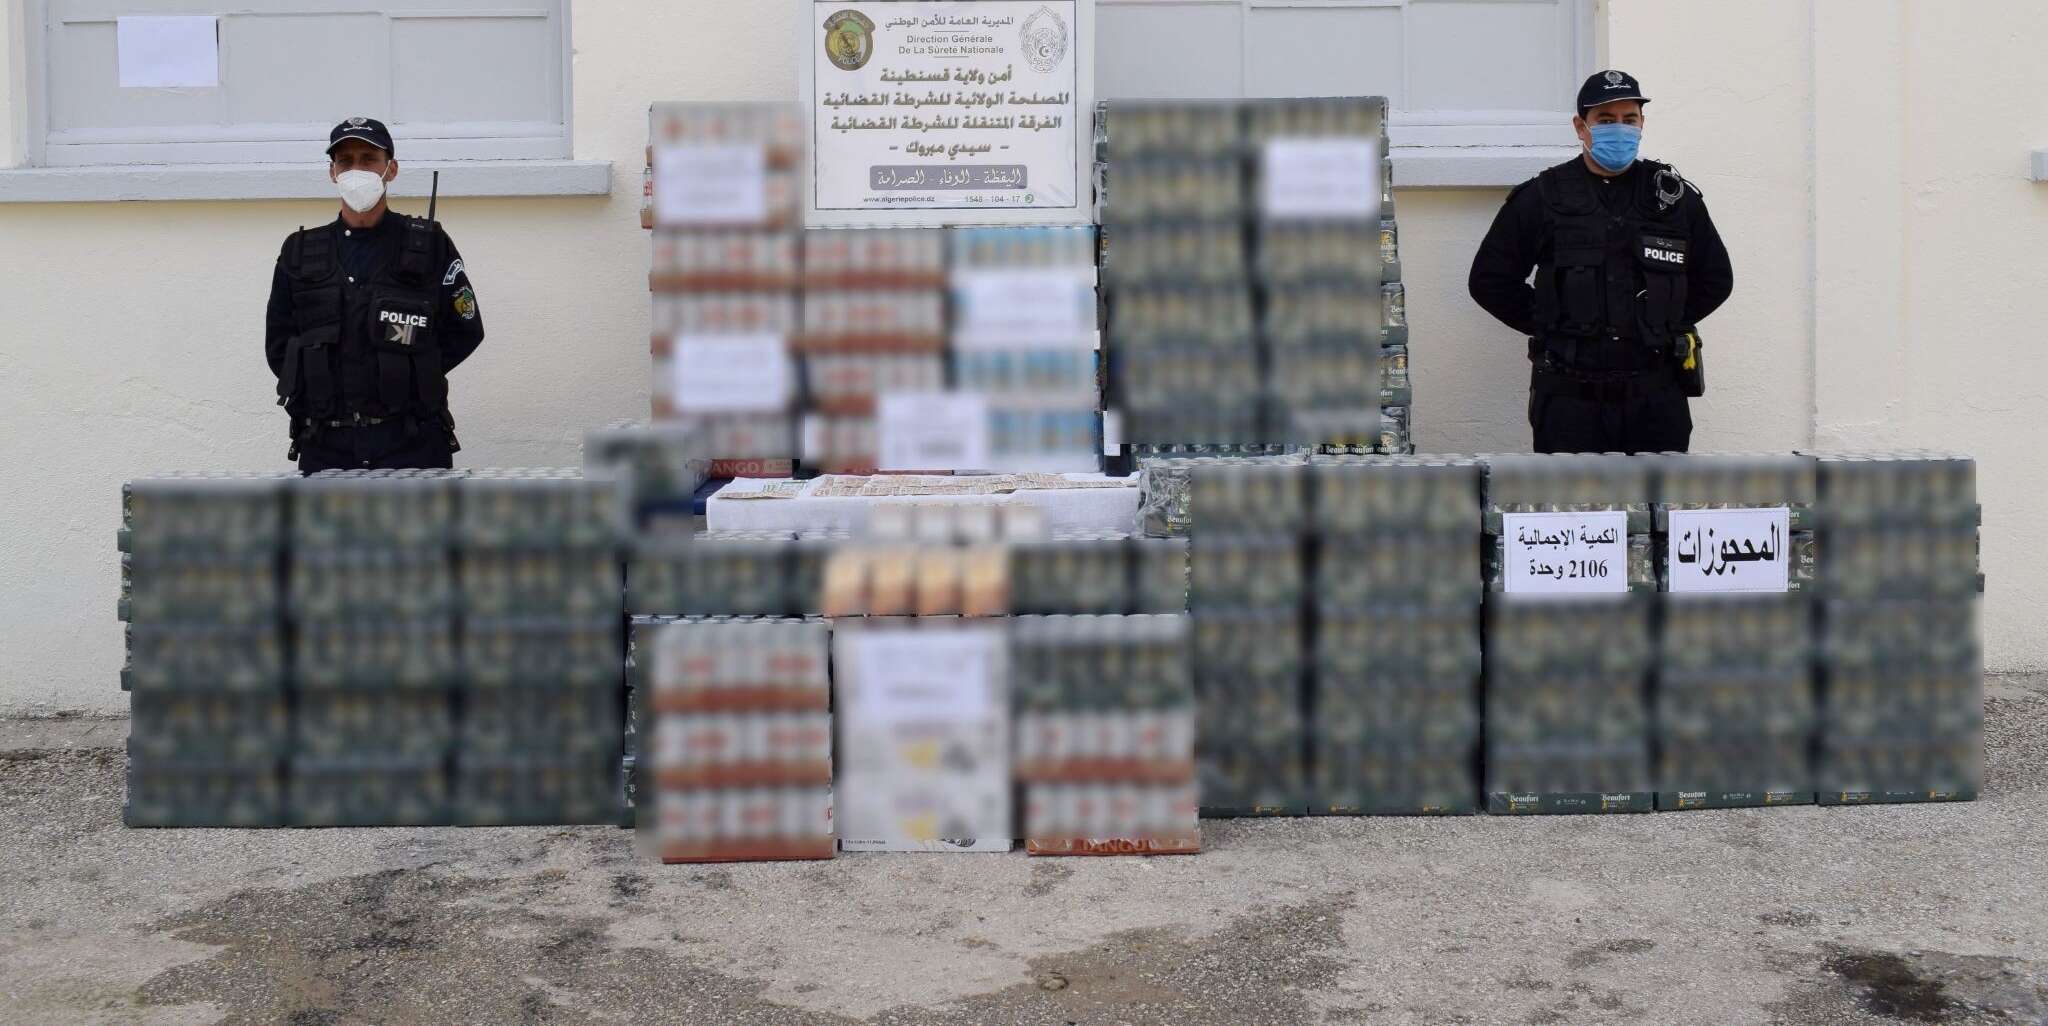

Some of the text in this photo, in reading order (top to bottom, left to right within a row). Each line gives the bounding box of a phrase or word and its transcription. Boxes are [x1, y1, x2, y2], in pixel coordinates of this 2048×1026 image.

[885, 16, 919, 32] الوطني
[921, 13, 946, 28] للأمن
[949, 15, 979, 25] العامة
[982, 15, 1014, 27] المديرية
[906, 34, 993, 43] Direction Générale
[898, 46, 911, 54] De
[913, 46, 926, 54] La
[960, 45, 1004, 54] Nationale
[880, 63, 1012, 86] أمن ولاية قسنطينة
[823, 90, 1070, 110] المصلحة الولائية للشرطة القضائية
[831, 113, 1062, 134] الفرقة المتنقلة للشرطة القضائية
[905, 141, 945, 157] مبروك
[947, 142, 992, 160] سيدي
[877, 167, 926, 188] الصرامة
[939, 168, 970, 187] الوفاء
[983, 167, 1022, 188] اليقظة
[1644, 247, 1685, 263] POLICE
[380, 310, 428, 327] POLICE
[711, 462, 759, 473] ANGO
[1518, 525, 1618, 551] الكمية الإجمالية
[1677, 520, 1781, 576] المحجوزات
[1529, 558, 1608, 579] 2106 وحدة
[1510, 794, 1539, 803] Beaufort
[1602, 793, 1632, 801] Beaufort
